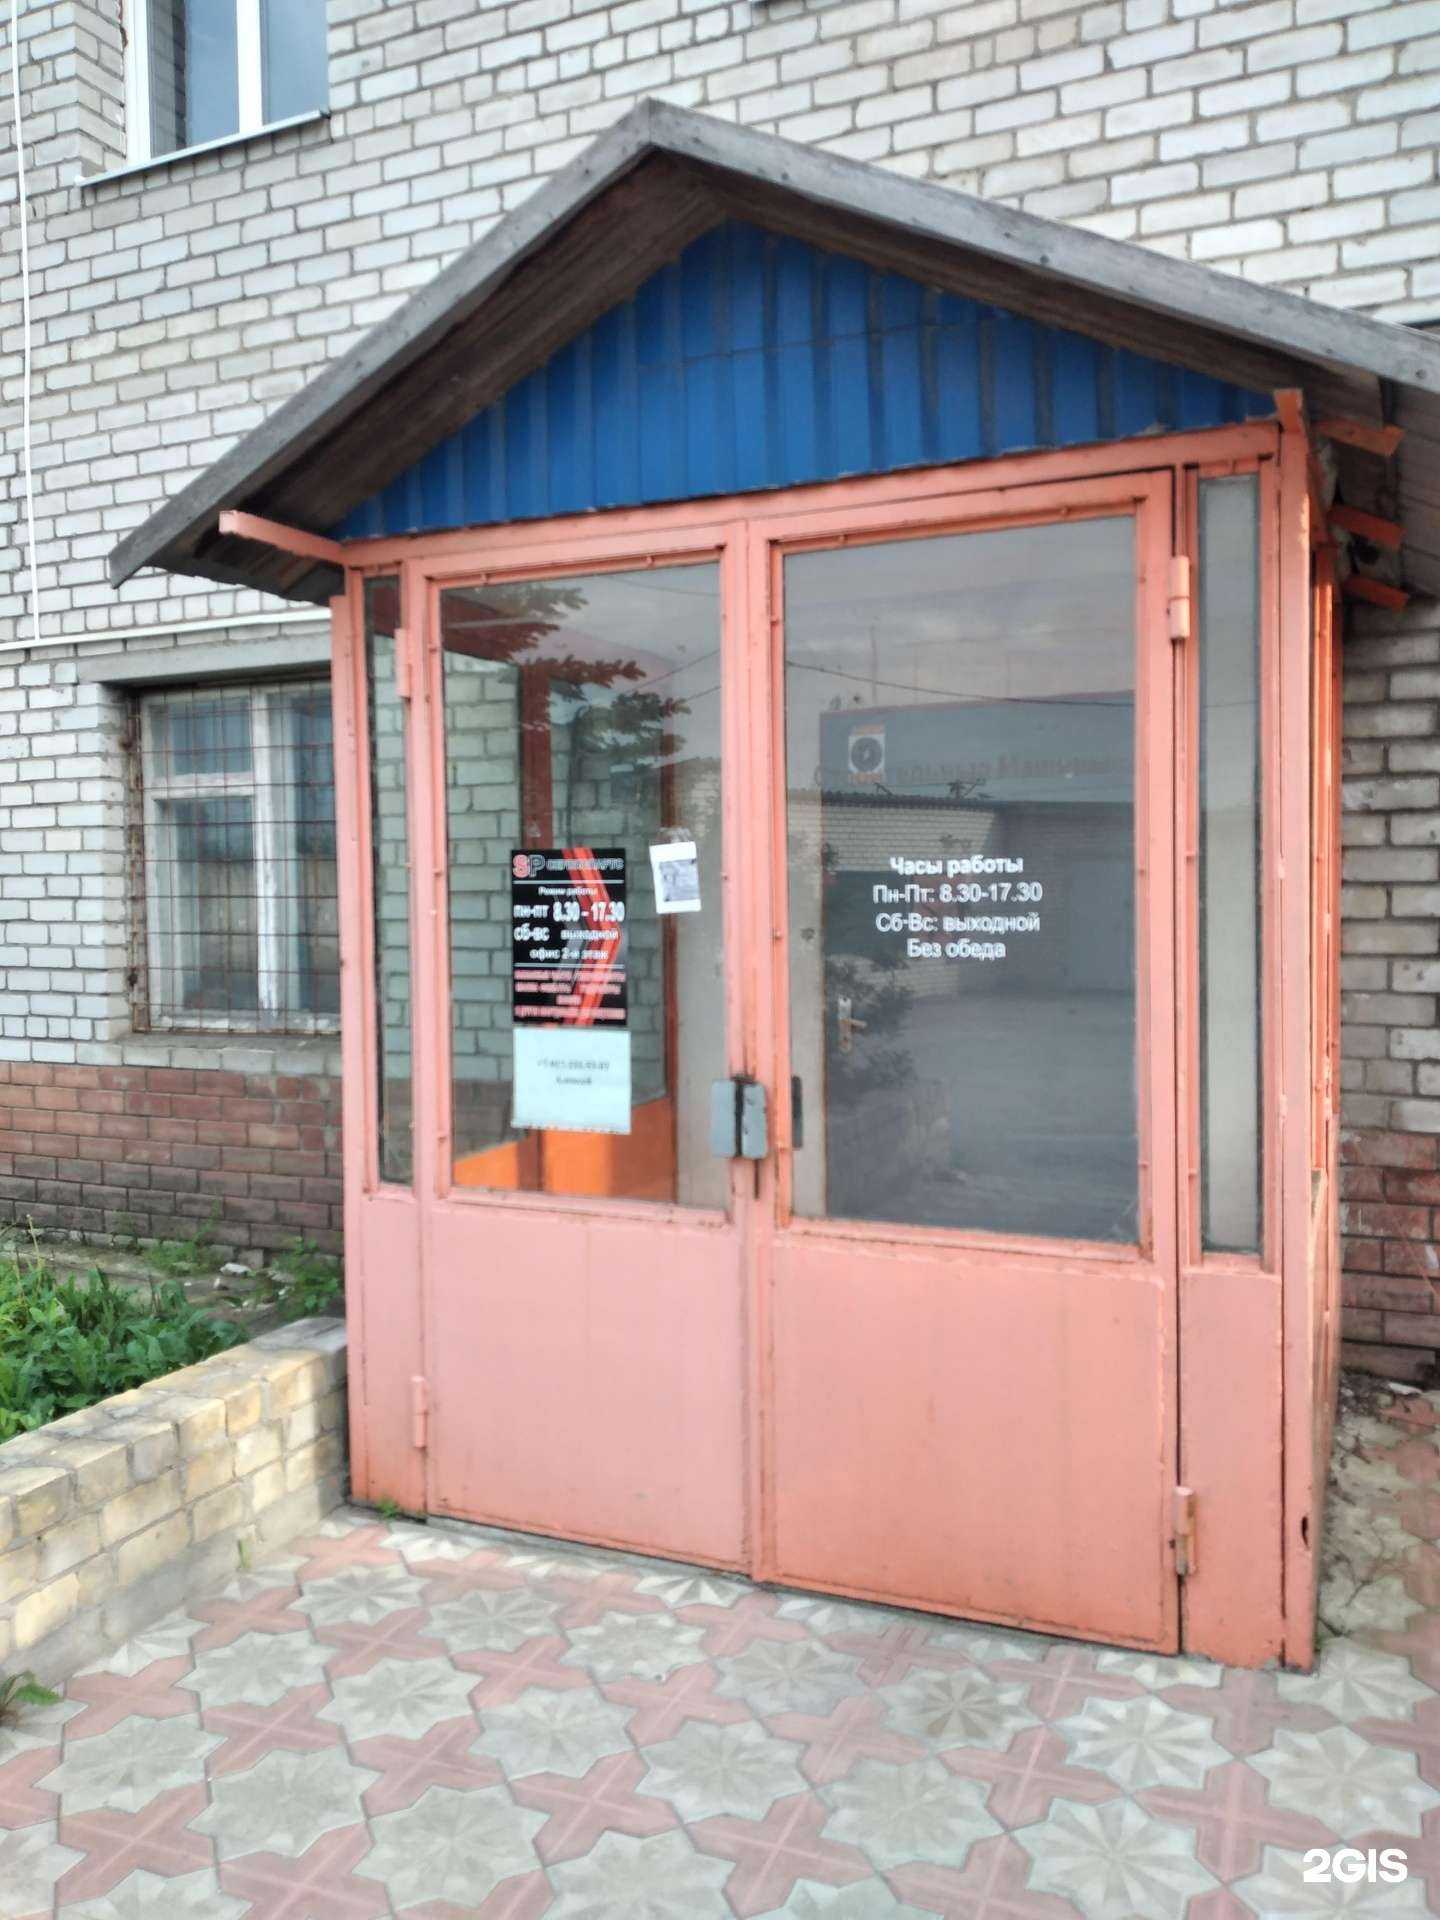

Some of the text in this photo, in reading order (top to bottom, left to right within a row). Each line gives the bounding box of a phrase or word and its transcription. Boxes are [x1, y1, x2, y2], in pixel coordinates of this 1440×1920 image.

[890, 855, 1024, 878] Часы работы
[873, 882, 1043, 903] Пн-Пт: 8.30-17.30
[553, 901, 580, 922] 8.30
[591, 901, 625, 922] 17.30
[875, 912, 1041, 934] Сб-Вс: выходной
[530, 947, 560, 961] офис
[907, 938, 1006, 960] Без обеда
